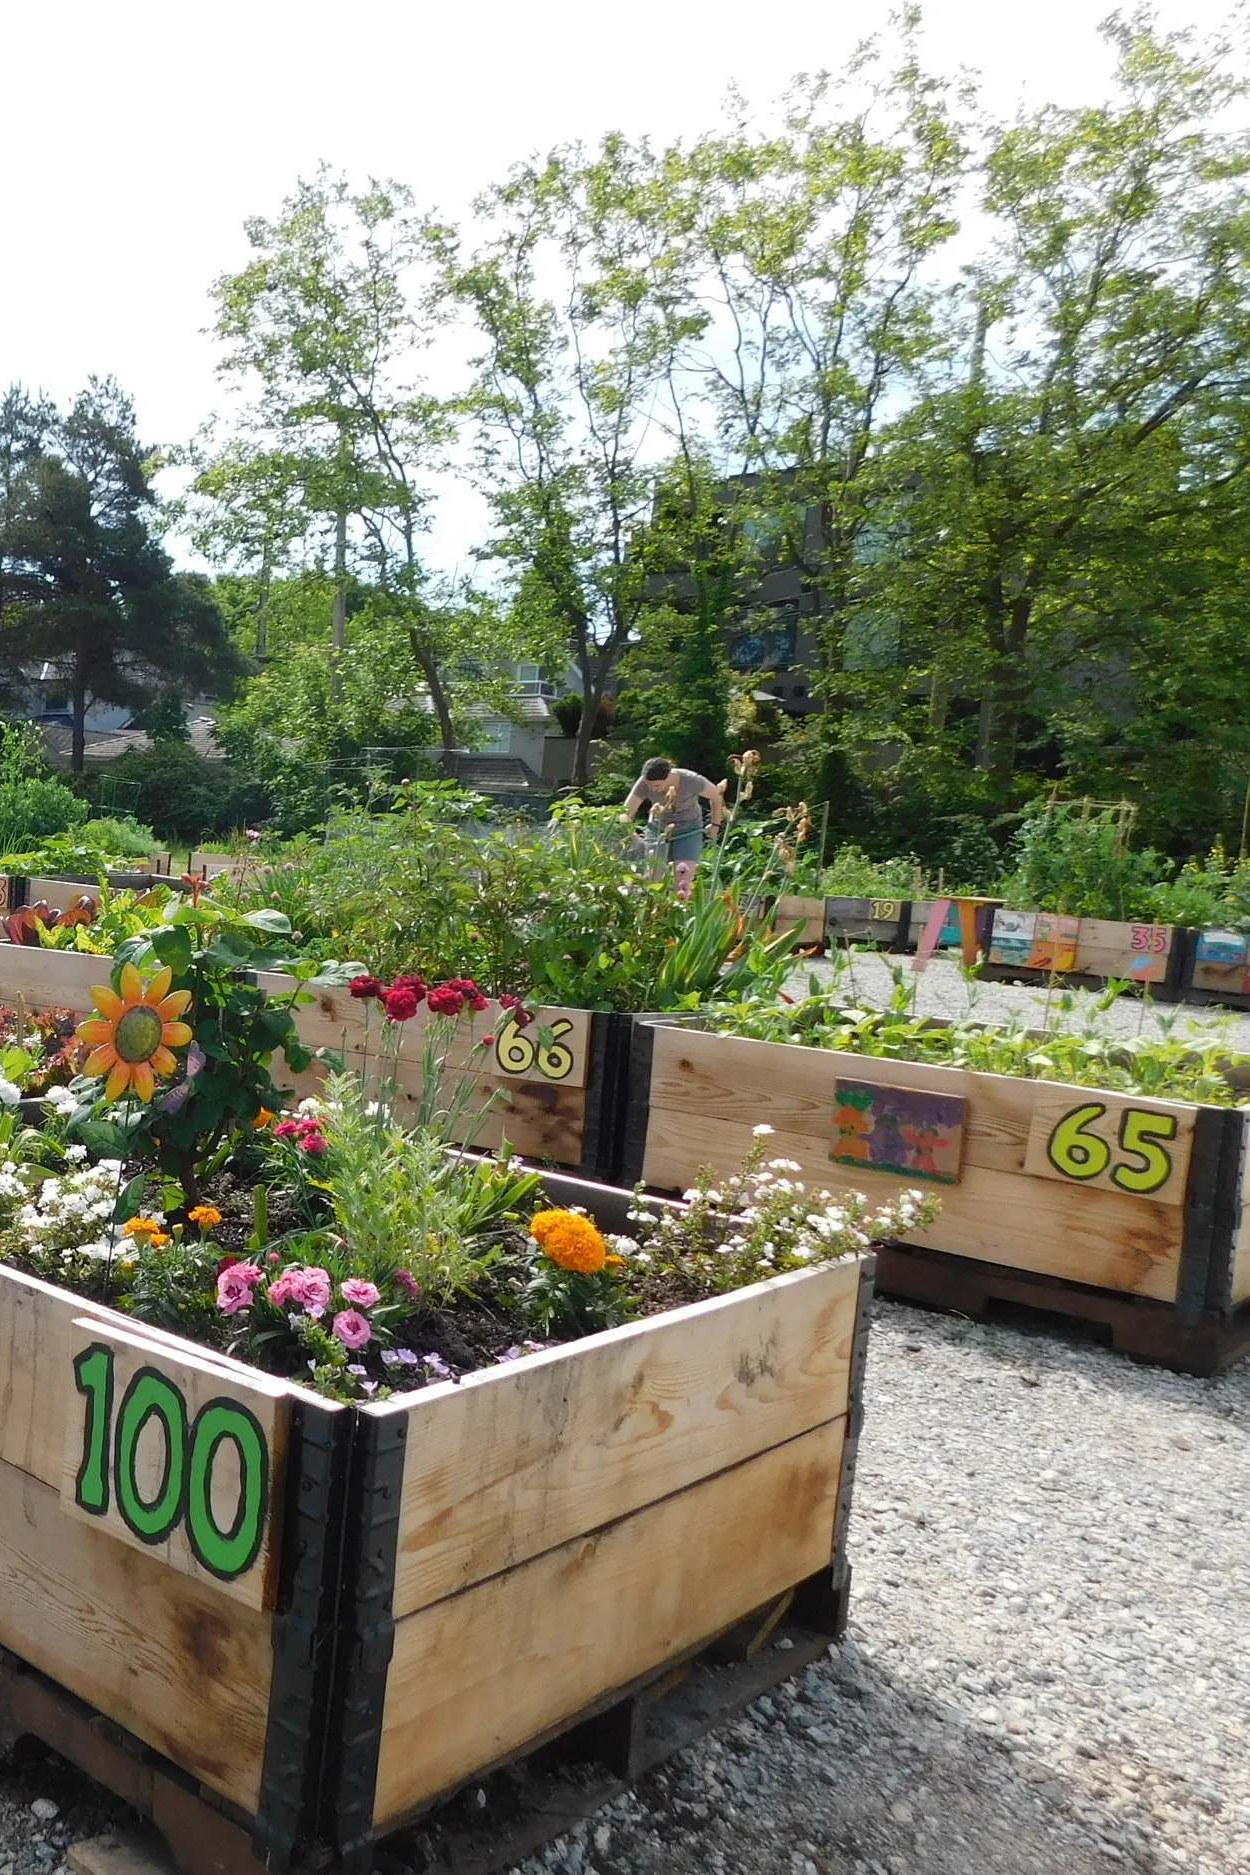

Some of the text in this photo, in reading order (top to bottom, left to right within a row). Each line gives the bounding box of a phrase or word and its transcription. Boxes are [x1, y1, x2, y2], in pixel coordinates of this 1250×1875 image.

[871, 900, 895, 920] 19
[1131, 926, 1167, 952] 35
[496, 1010, 574, 1080] 66
[1047, 1102, 1177, 1194] 65
[72, 1341, 270, 1583] 100
